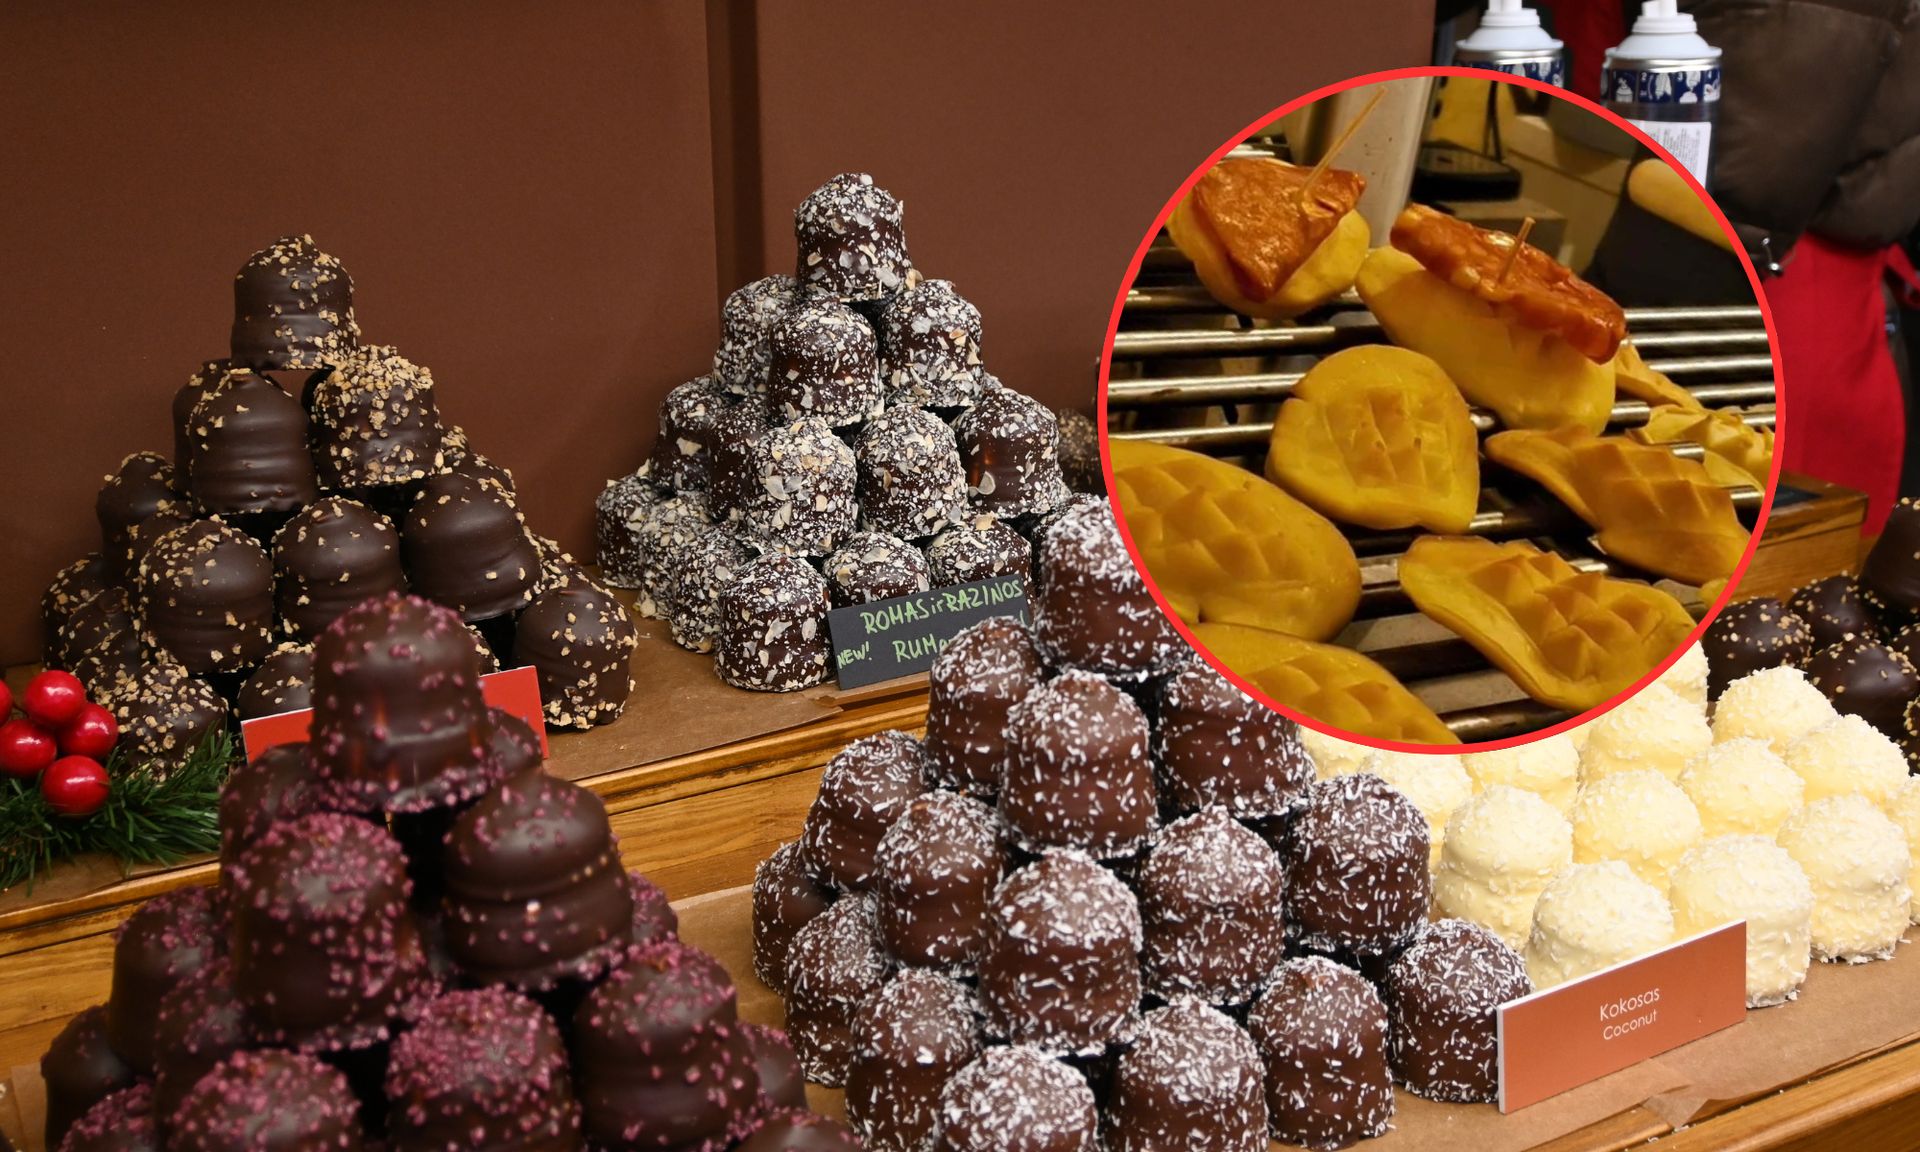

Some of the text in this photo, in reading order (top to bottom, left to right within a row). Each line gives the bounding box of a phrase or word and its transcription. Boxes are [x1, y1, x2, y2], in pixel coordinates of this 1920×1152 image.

[860, 598, 930, 634] ROMAS
[941, 579, 1024, 612] RAZINOS
[836, 640, 873, 669] NEW!
[1600, 988, 1660, 1022] Kokosas
[1603, 1009, 1656, 1040] Coconut
